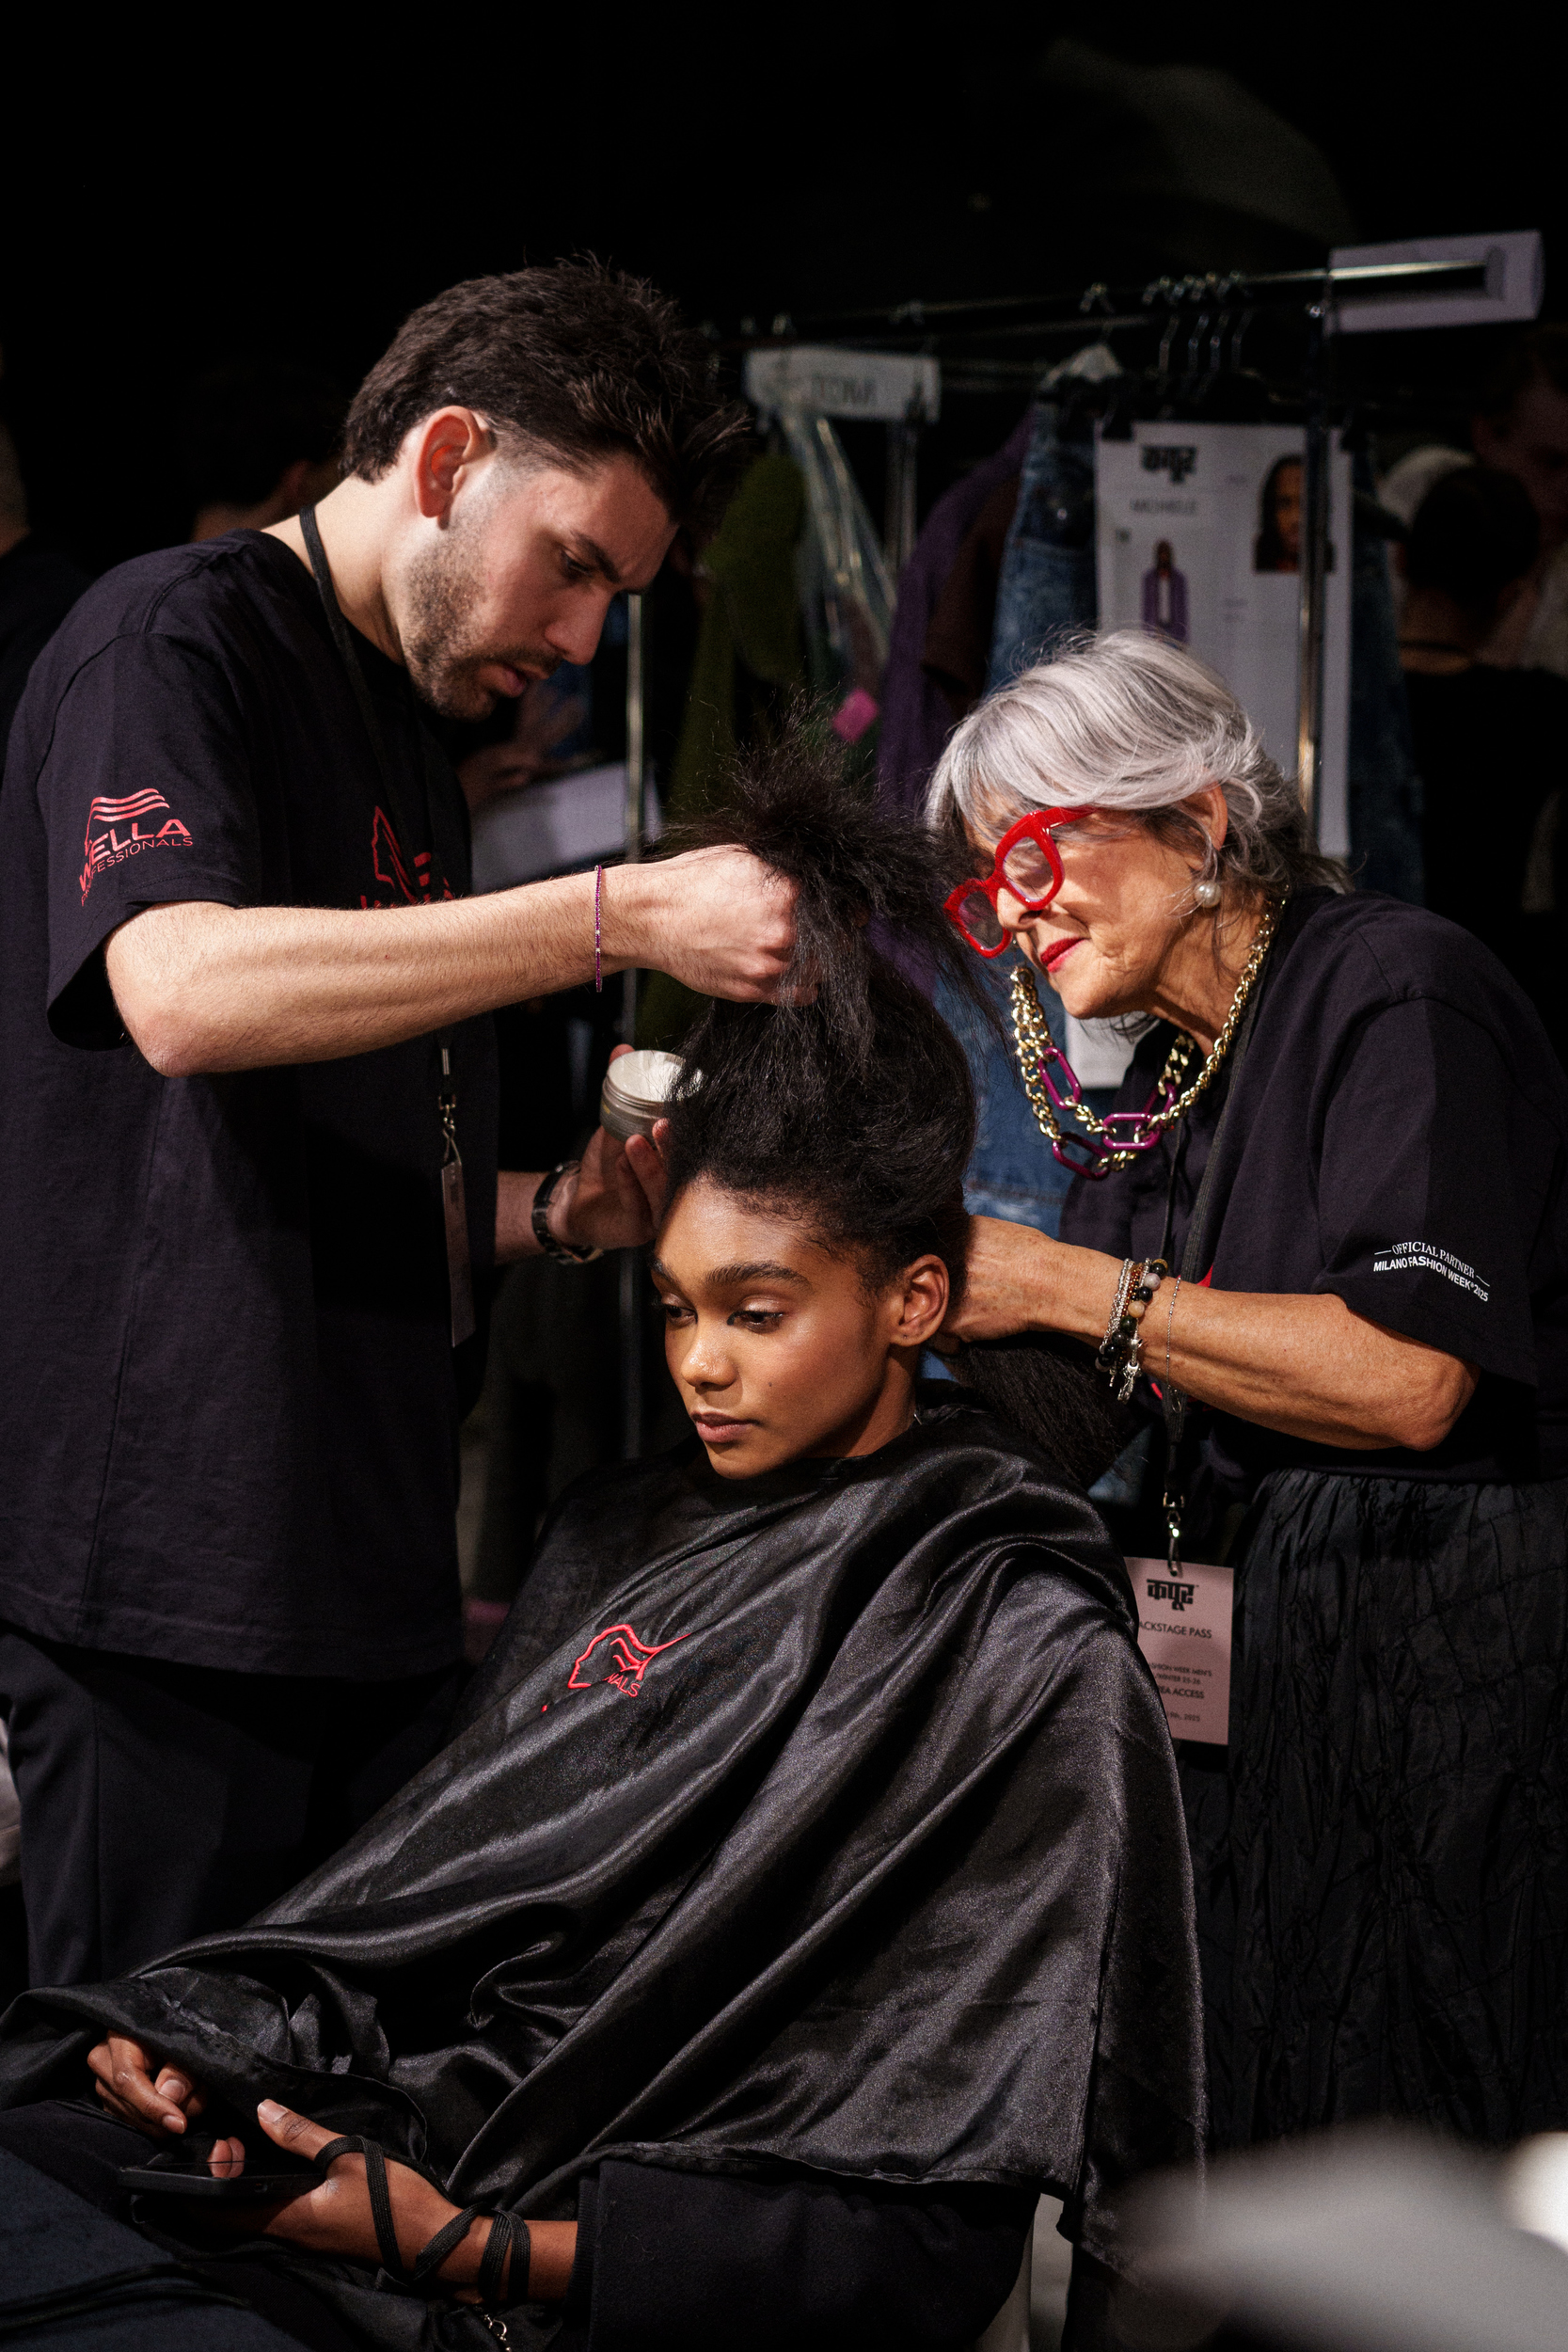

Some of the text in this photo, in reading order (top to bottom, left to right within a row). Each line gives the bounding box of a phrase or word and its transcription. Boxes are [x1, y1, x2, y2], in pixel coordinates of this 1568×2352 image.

[1373, 1258, 1408, 1272] MILANO
[1408, 1255, 1448, 1277] FASHION
[1392, 1241, 1475, 1279] OFFICIAL PARTNER
[1139, 1620, 1212, 1639] ACKSTAGE PASS
[1172, 1687, 1205, 1700] ACCESS
